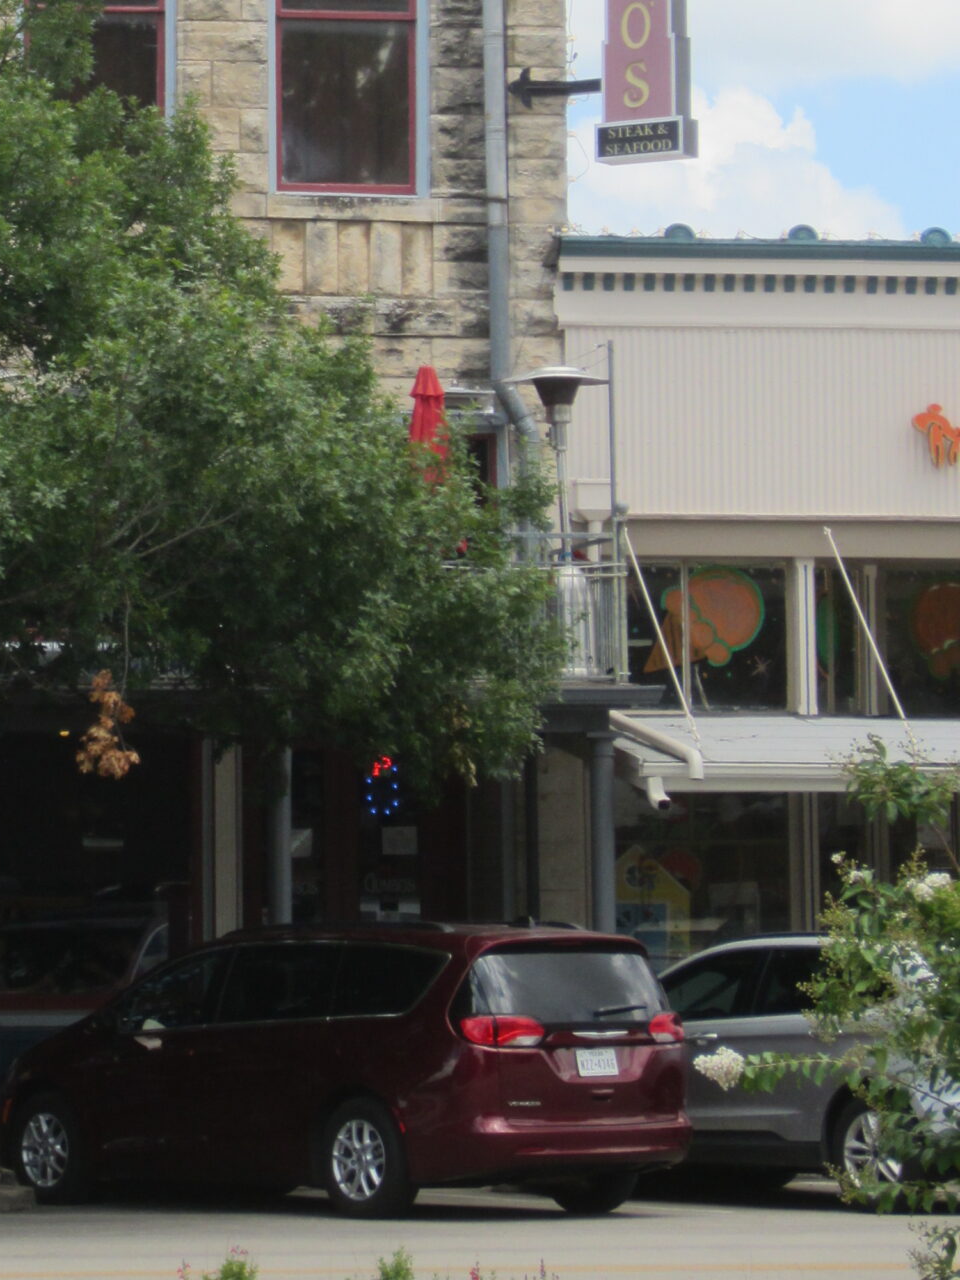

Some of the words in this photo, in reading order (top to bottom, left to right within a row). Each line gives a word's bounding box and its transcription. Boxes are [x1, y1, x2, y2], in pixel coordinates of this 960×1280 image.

[608, 124, 653, 139] STEAK
[657, 123, 668, 135] &
[605, 138, 672, 156] SEAFOOD
